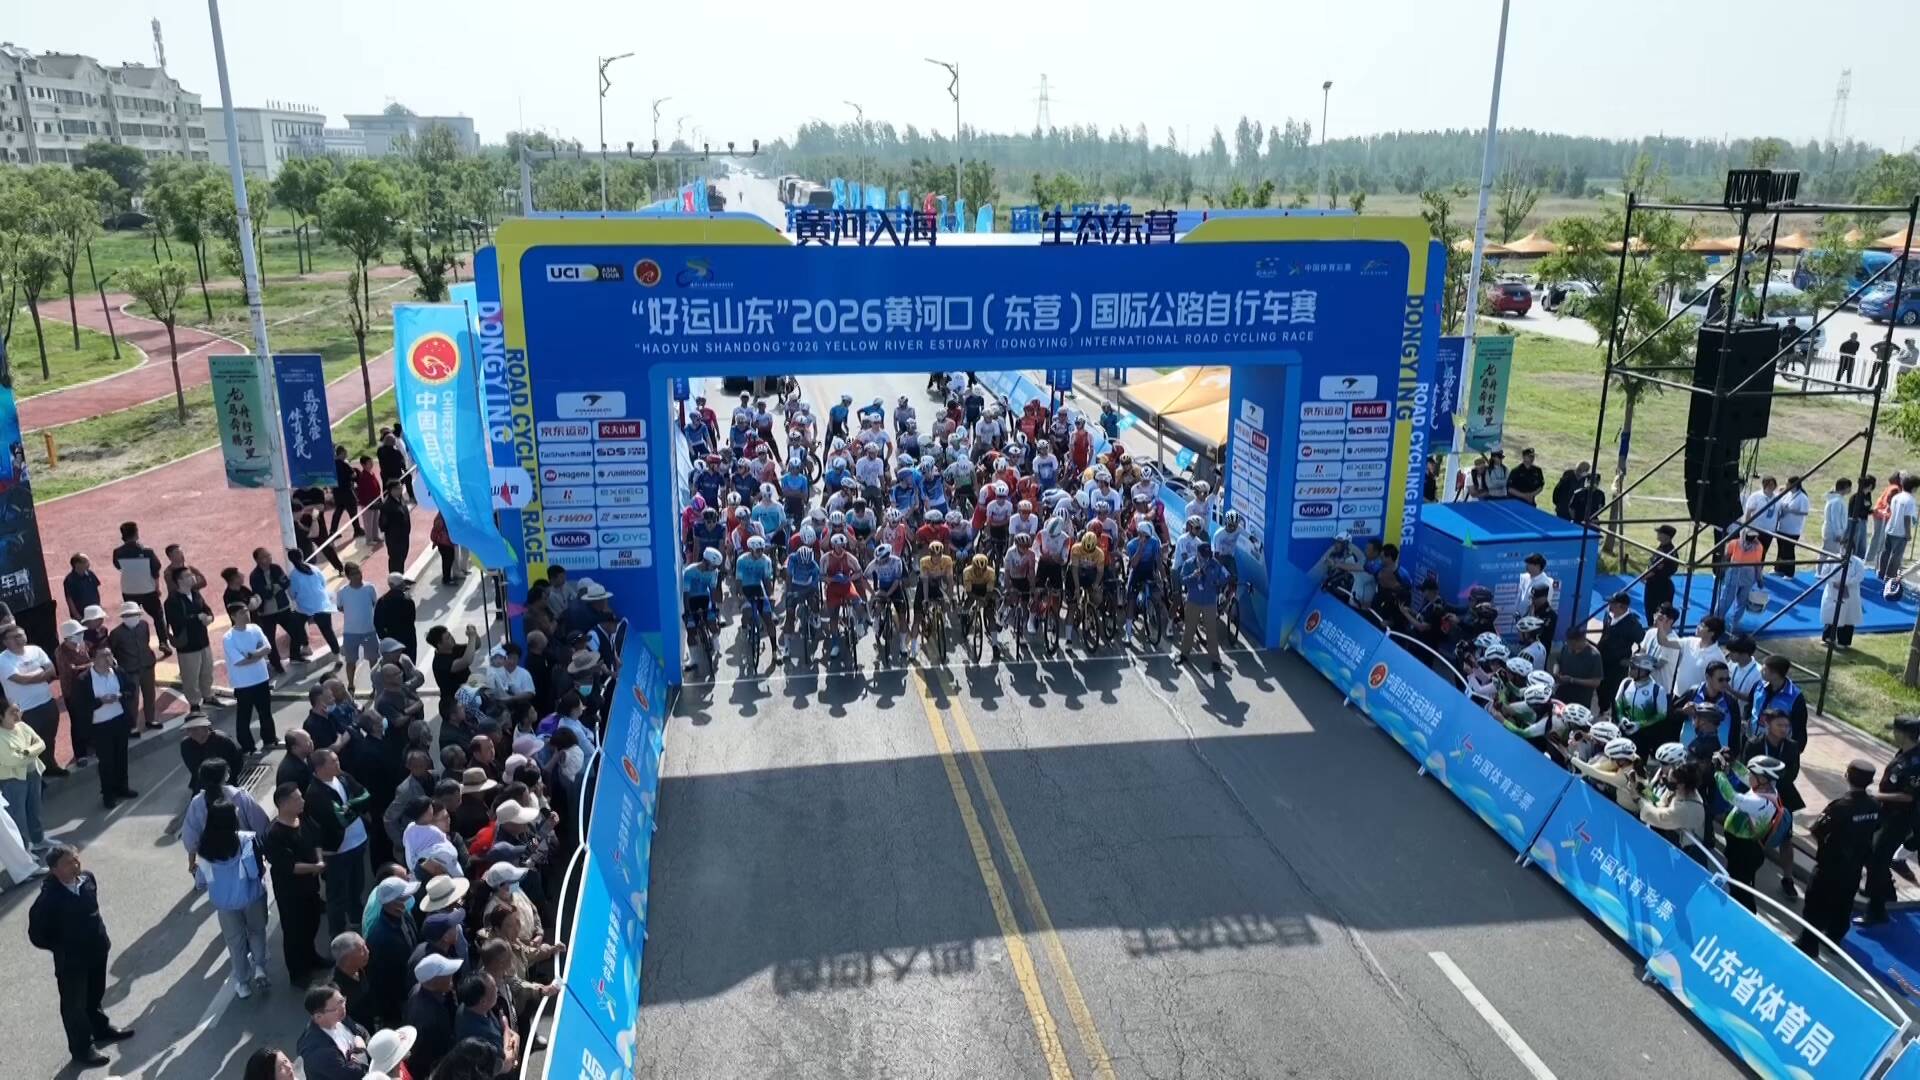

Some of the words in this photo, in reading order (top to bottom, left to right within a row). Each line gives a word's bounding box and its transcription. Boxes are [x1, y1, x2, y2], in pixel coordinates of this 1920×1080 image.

[550, 267, 580, 279] UCI
[825, 340, 878, 351] YELLOW
[885, 340, 923, 350] RIVER
[930, 338, 988, 350] ESTUARY
[1080, 334, 1179, 347] INTERNATIONAL
[1185, 333, 1218, 344] ROAD
[1224, 331, 1276, 343] CYCLING
[1282, 331, 1314, 342] RACE
[1395, 295, 1423, 421] DONGYING
[478, 302, 513, 443] DONGYING
[1412, 383, 1429, 427] ROAD
[506, 349, 529, 407] ROAD
[522, 511, 543, 563] RACE
[1404, 431, 1424, 499] CYCLING
[1301, 506, 1330, 514] MKMK
[1400, 504, 1417, 545] RACE
[554, 535, 588, 545] MKMK
[1472, 753, 1536, 811] 中国体育彩票
[1590, 846, 1677, 921] 中国体育彩票
[1690, 935, 1836, 1067] 山东省体育局
